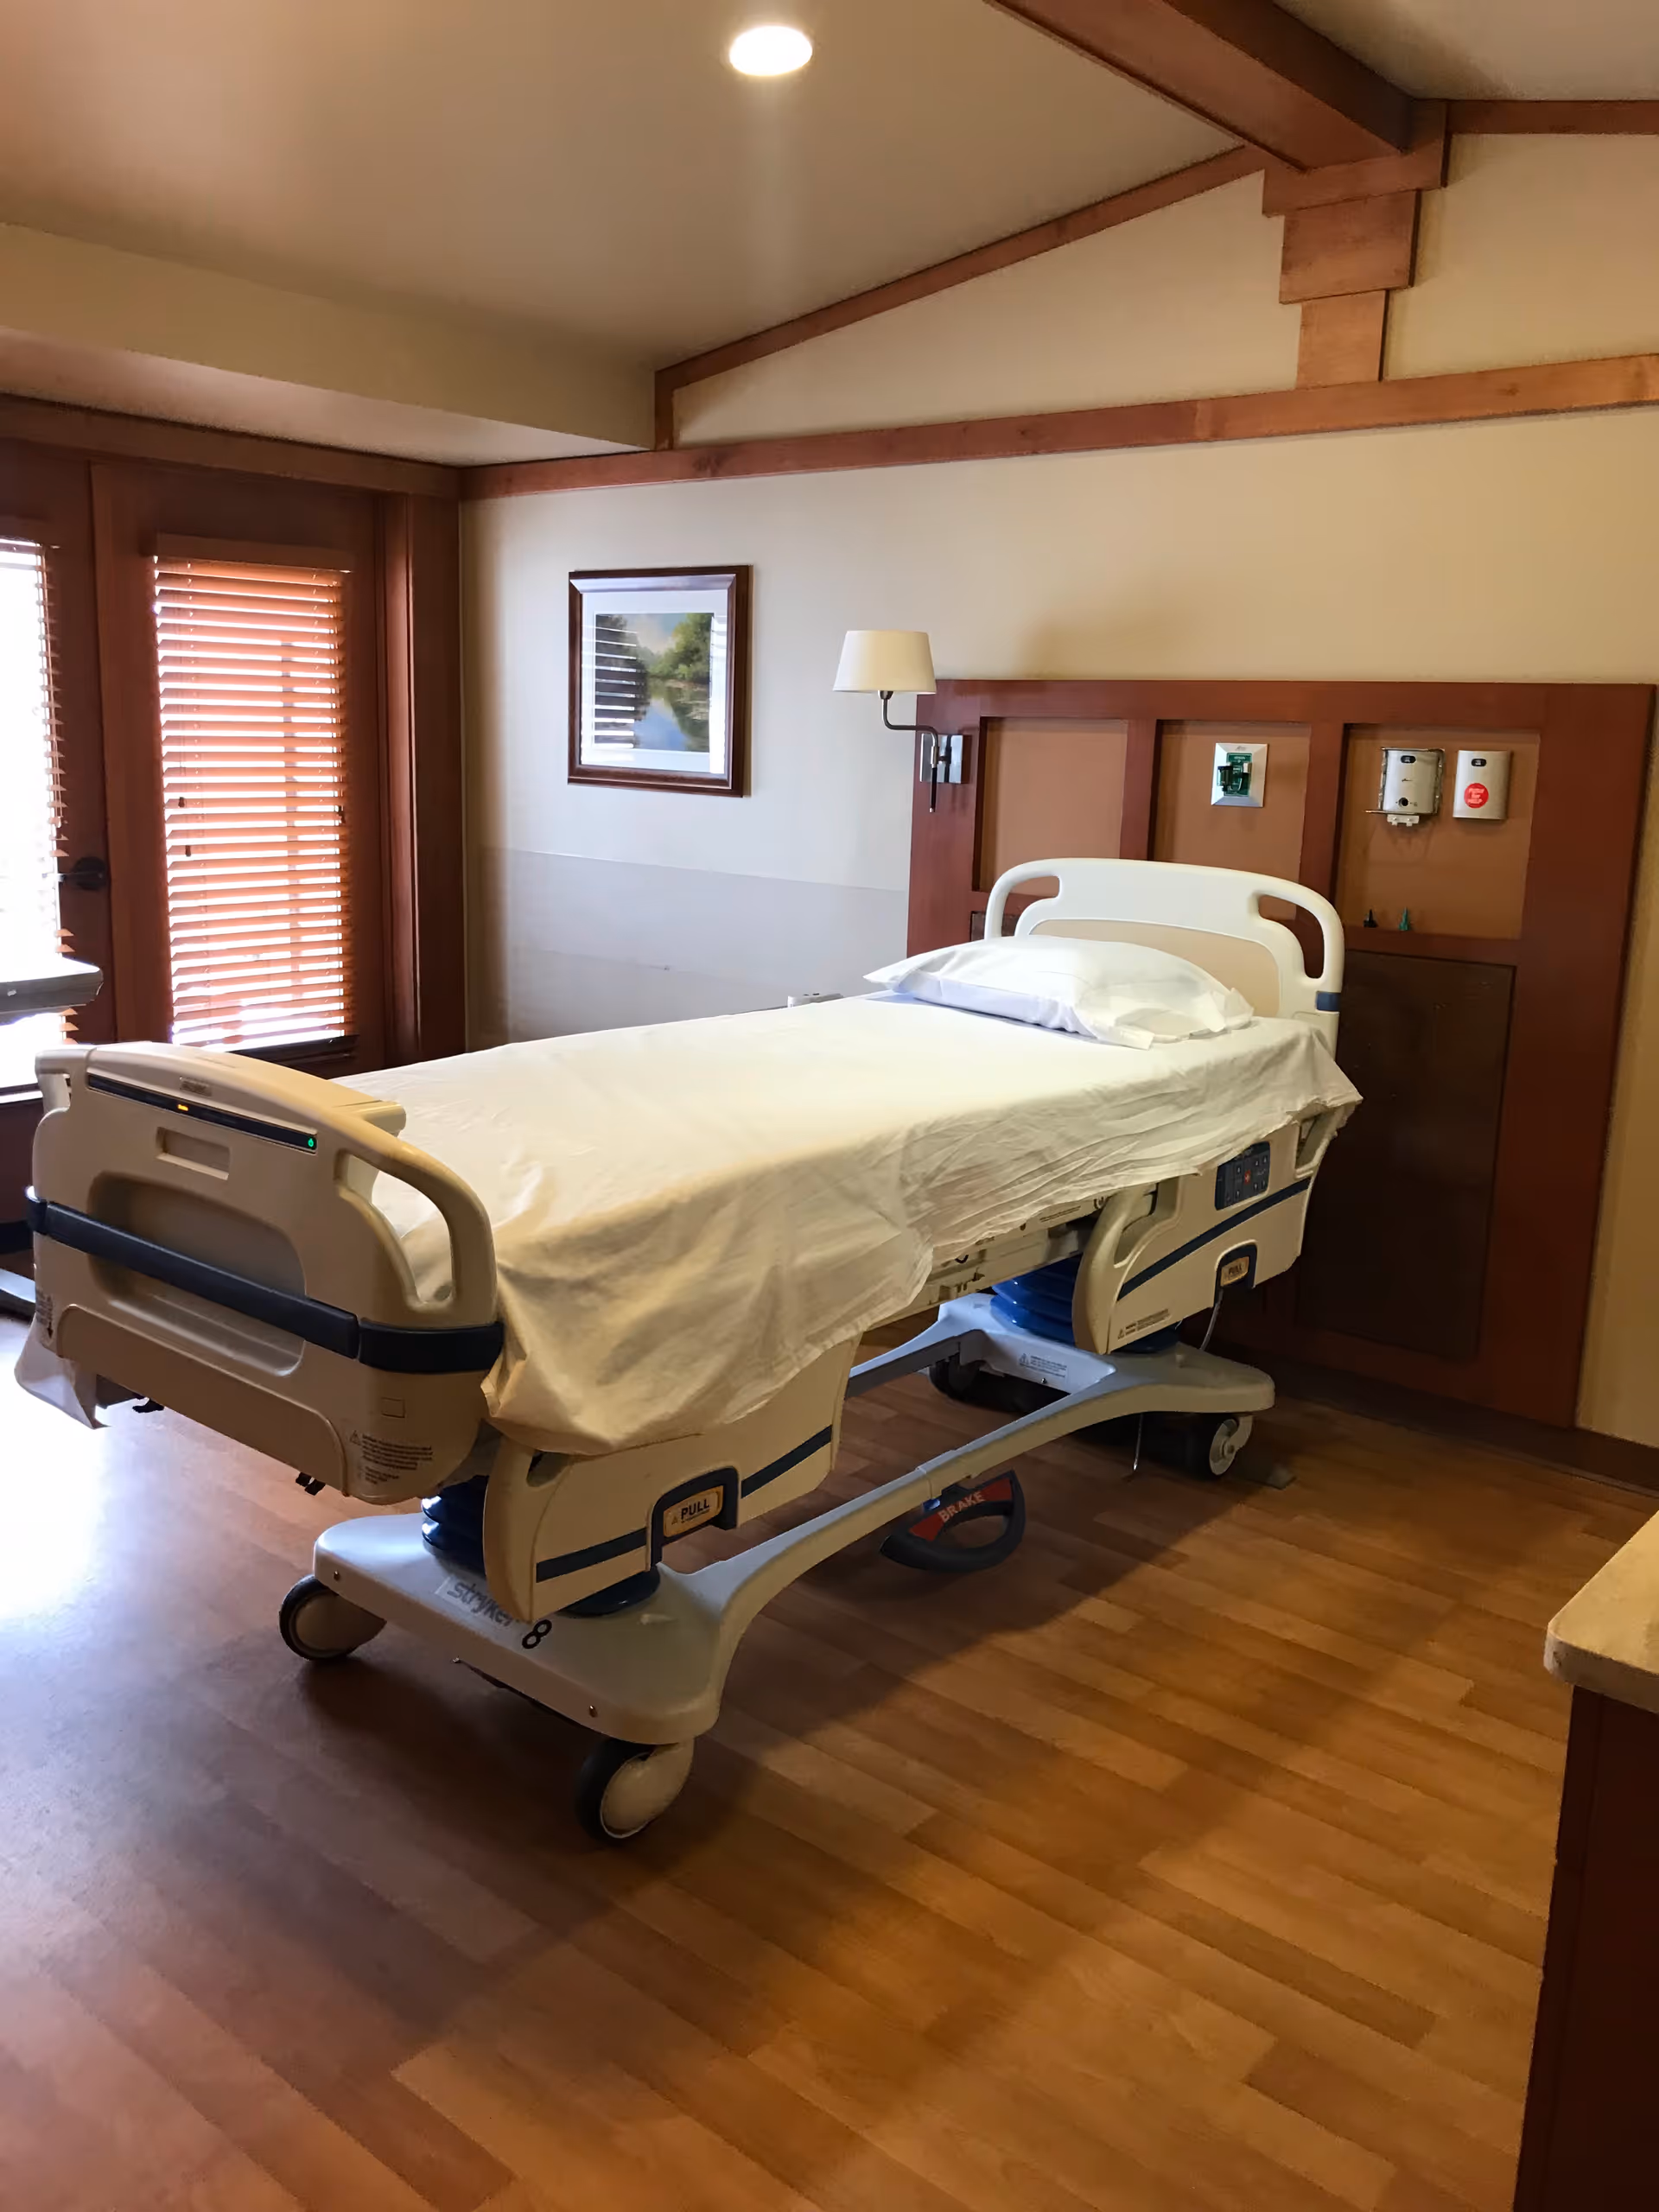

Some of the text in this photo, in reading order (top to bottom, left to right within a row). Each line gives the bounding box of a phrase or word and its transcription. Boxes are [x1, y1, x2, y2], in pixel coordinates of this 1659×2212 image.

[680, 1499, 710, 1520] PULL
[938, 1491, 986, 1523] BRAKE
[521, 1618, 553, 1649] 8
